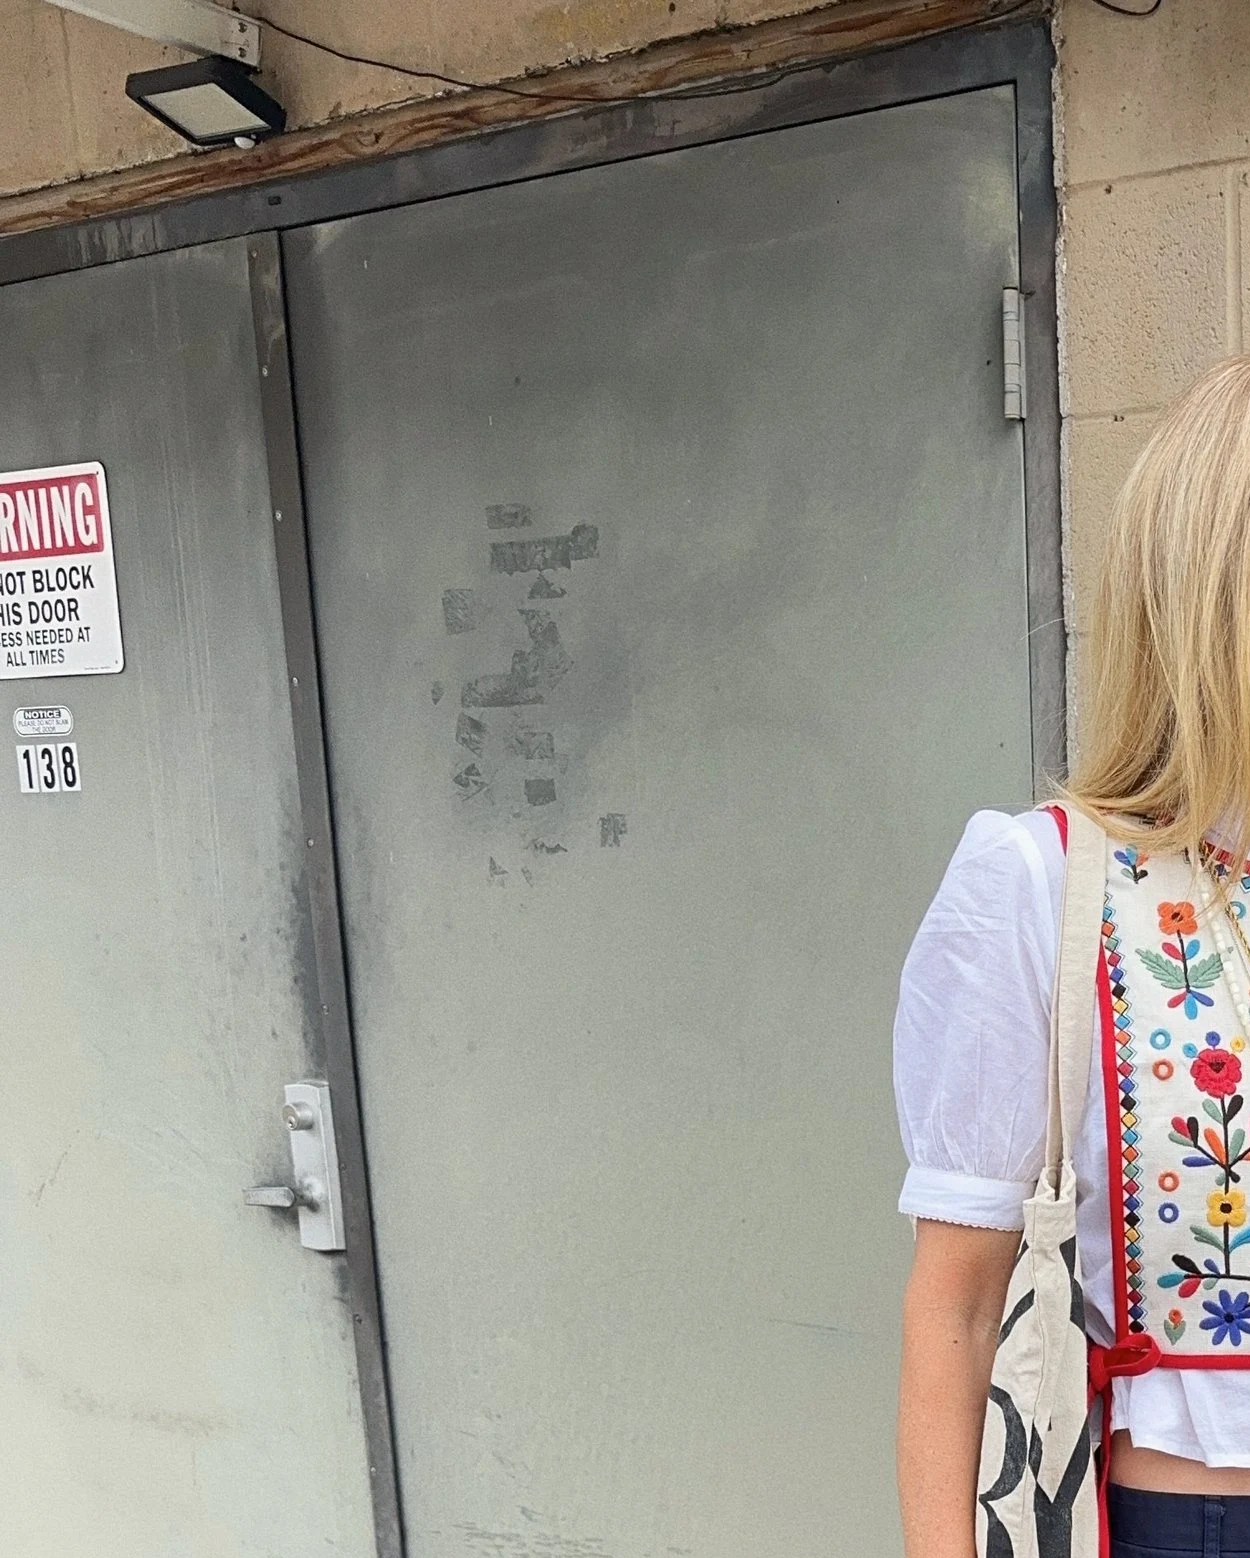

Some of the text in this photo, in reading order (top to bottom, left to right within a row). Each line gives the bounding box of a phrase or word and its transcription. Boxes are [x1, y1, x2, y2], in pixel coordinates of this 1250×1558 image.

[32, 565, 95, 593] BLOCK
[28, 598, 80, 624] DOOR
[0, 626, 91, 648] ESS NEEDED AT
[6, 648, 65, 667] ALL TIMES
[25, 710, 60, 719] NOTICE
[23, 746, 77, 789] 138
